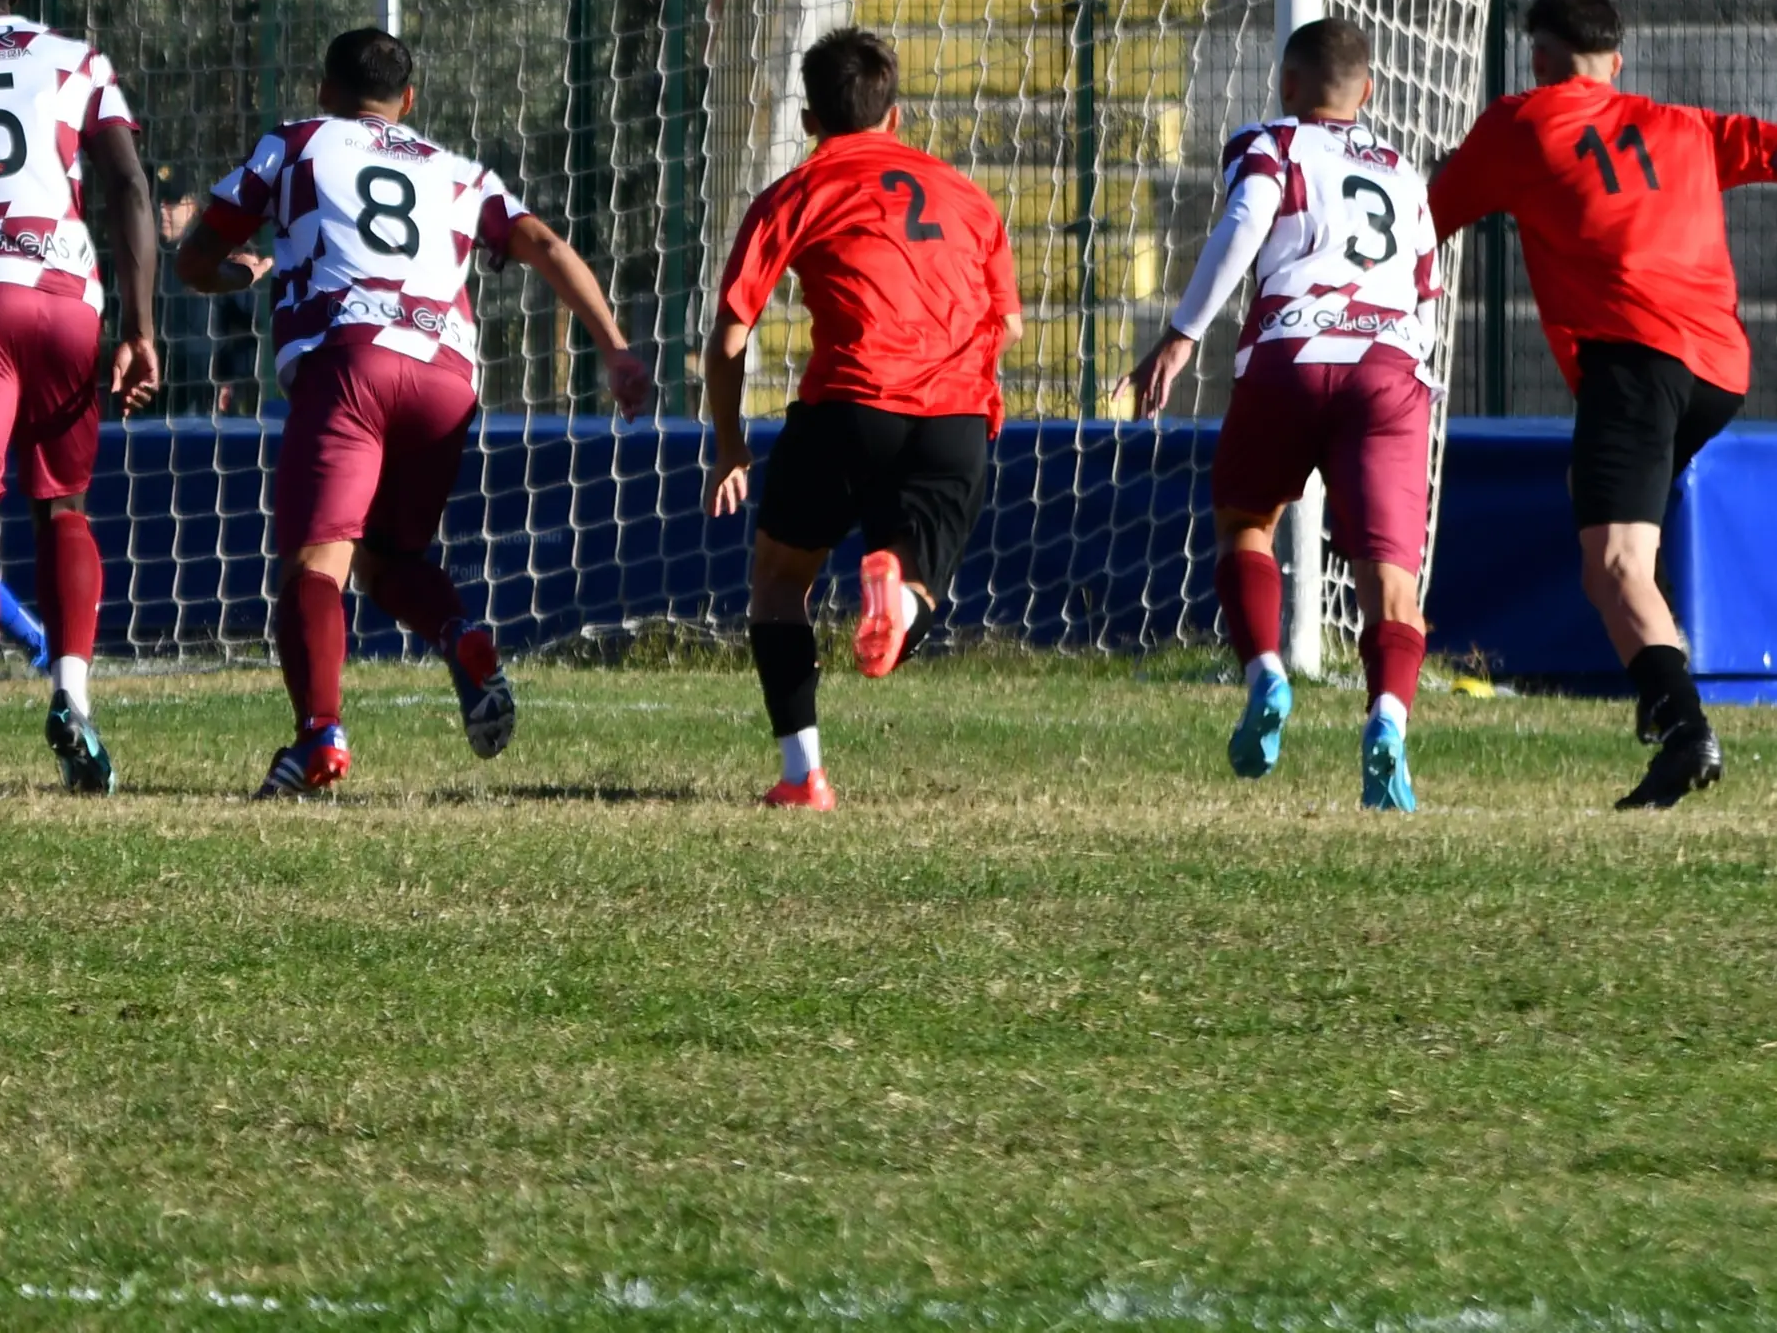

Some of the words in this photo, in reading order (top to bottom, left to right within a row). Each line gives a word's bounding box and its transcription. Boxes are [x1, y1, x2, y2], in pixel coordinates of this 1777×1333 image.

[1574, 124, 1661, 195] 11
[356, 165, 420, 259] 8
[880, 169, 944, 242] 2
[1342, 174, 1398, 267] 3
